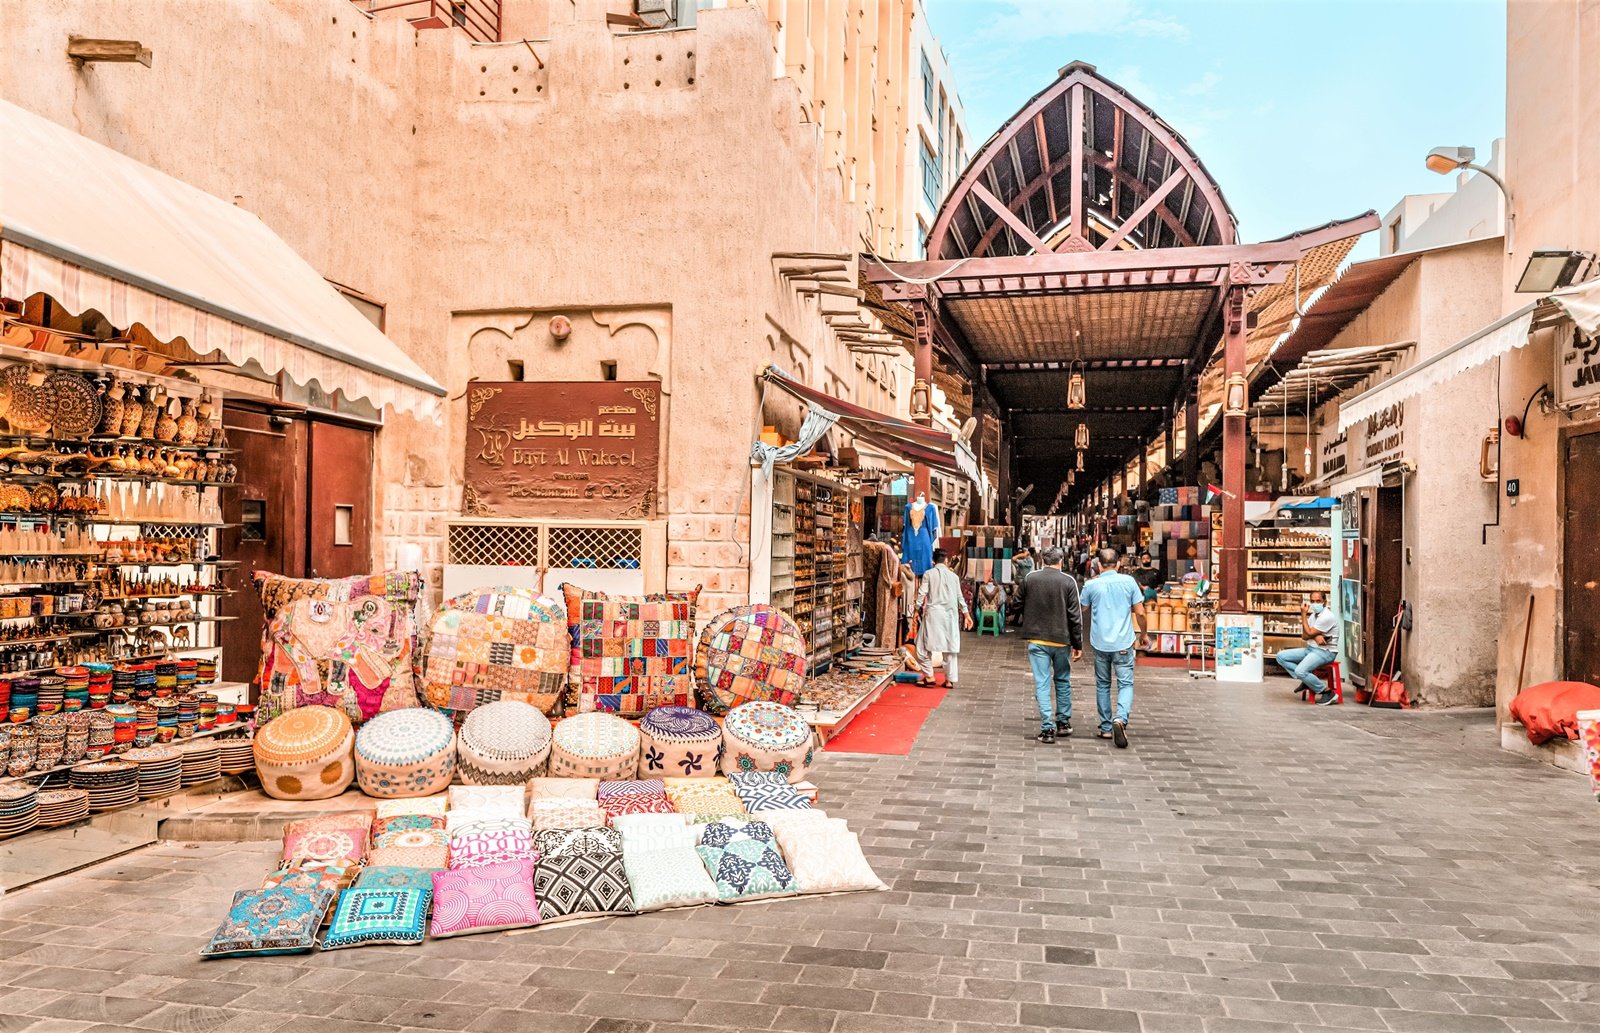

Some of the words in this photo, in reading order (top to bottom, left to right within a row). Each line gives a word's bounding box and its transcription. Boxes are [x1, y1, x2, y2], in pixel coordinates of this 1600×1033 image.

[598, 405, 637, 416] مطعم
[512, 418, 593, 441] الوكيل
[598, 419, 636, 440] بيت
[512, 448, 548, 471] Bayt
[554, 449, 570, 466] Al
[576, 448, 636, 467] Wakeel
[510, 485, 579, 499] Restaurant
[584, 484, 597, 499] &
[1507, 477, 1518, 493] 40
